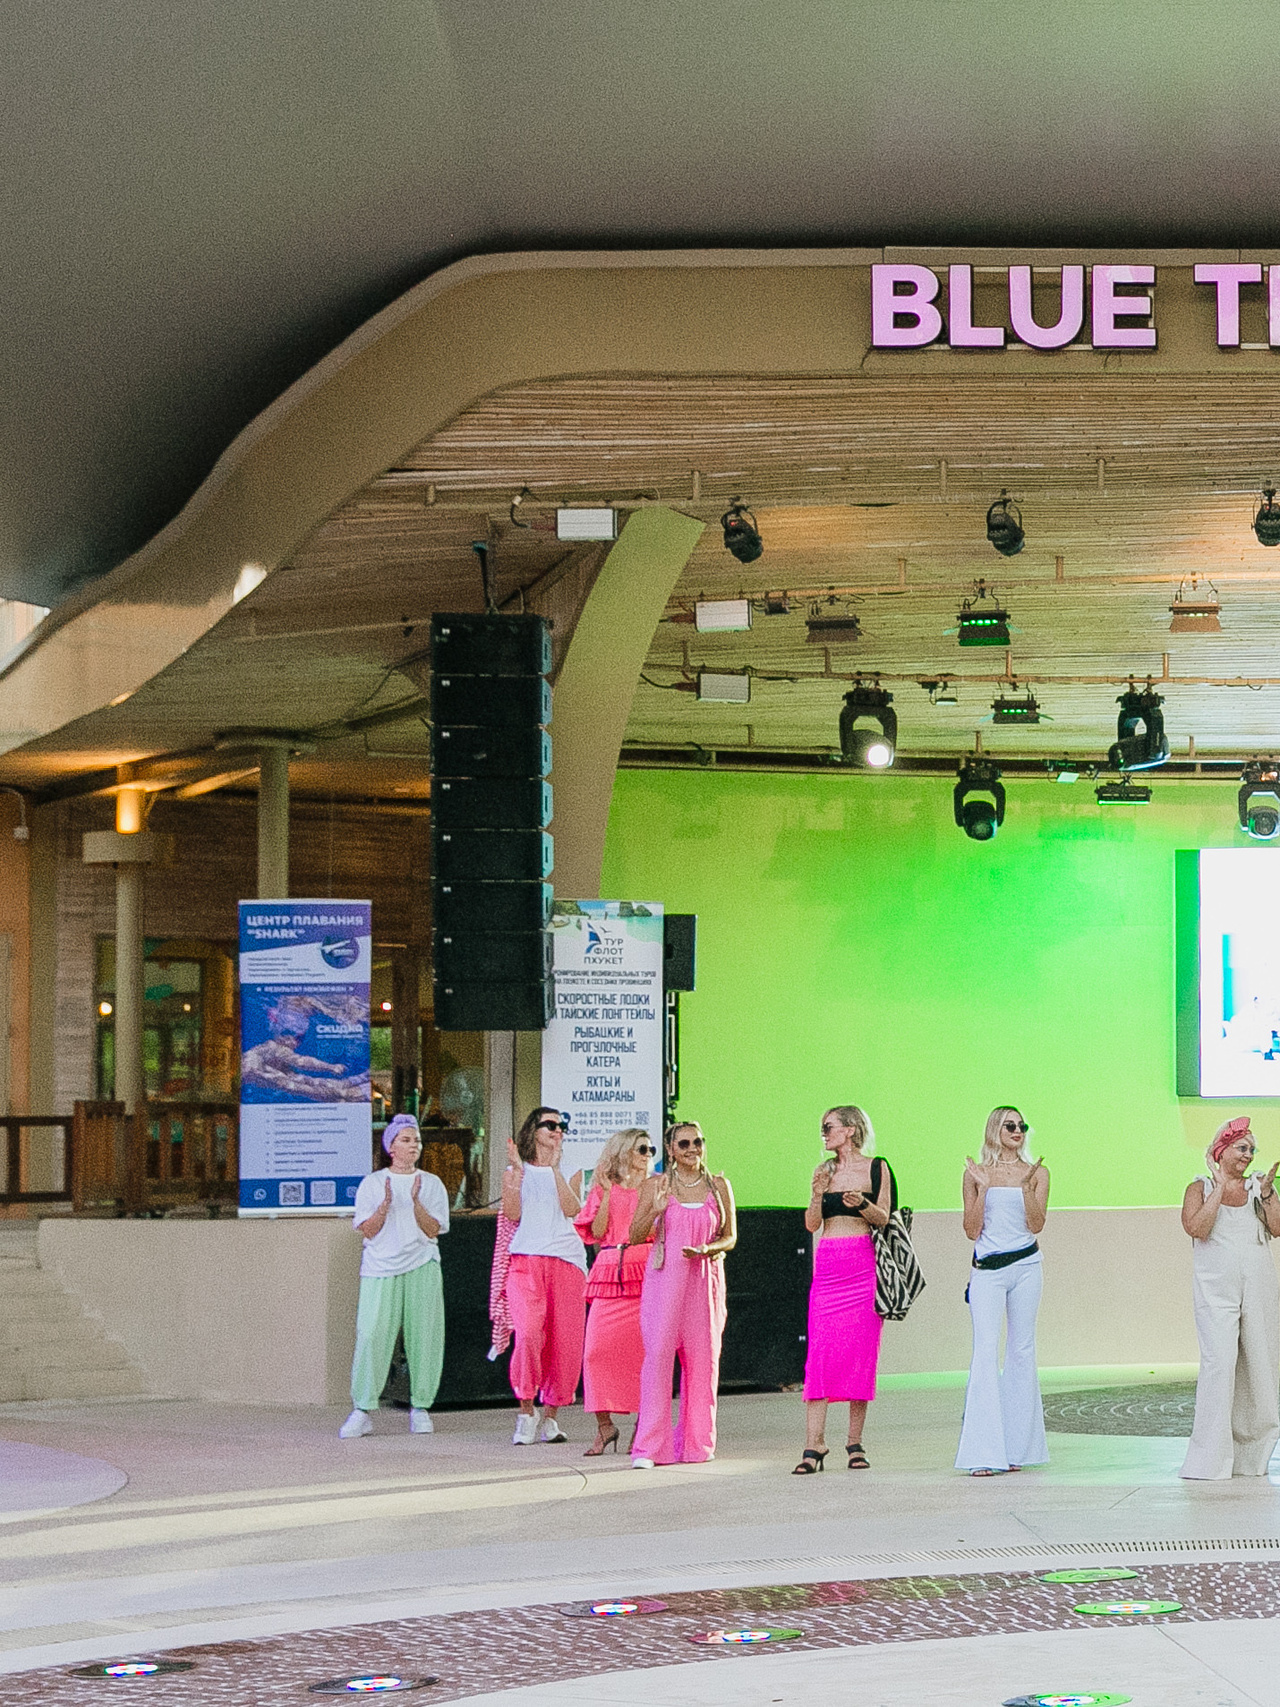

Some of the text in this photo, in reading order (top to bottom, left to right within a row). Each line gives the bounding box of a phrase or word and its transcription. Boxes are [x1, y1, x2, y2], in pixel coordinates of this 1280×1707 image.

[871, 263, 1157, 349] BLUE
[247, 915, 363, 926] ЦЕНТР ПЛАВАНИЯ
[594, 947, 624, 956] ФЛОТ
[584, 956, 624, 964] ПХУКЕТ
[557, 993, 650, 1006] СКОРОСТНЫЕ ЛОДКИ
[560, 1008, 599, 1020] ТАЙСКИЕ
[602, 1008, 656, 1020] ЛОНГТЕЙЛЫ
[574, 1026, 634, 1038] РЫБАЦКИЕ И
[570, 1042, 637, 1052] ПРОГУЛОЧНЫЕ
[586, 1056, 621, 1068] КАТЕРА
[586, 1076, 621, 1087] ЯХТЫ И
[572, 1090, 636, 1102] КАТАМАРАНЫ
